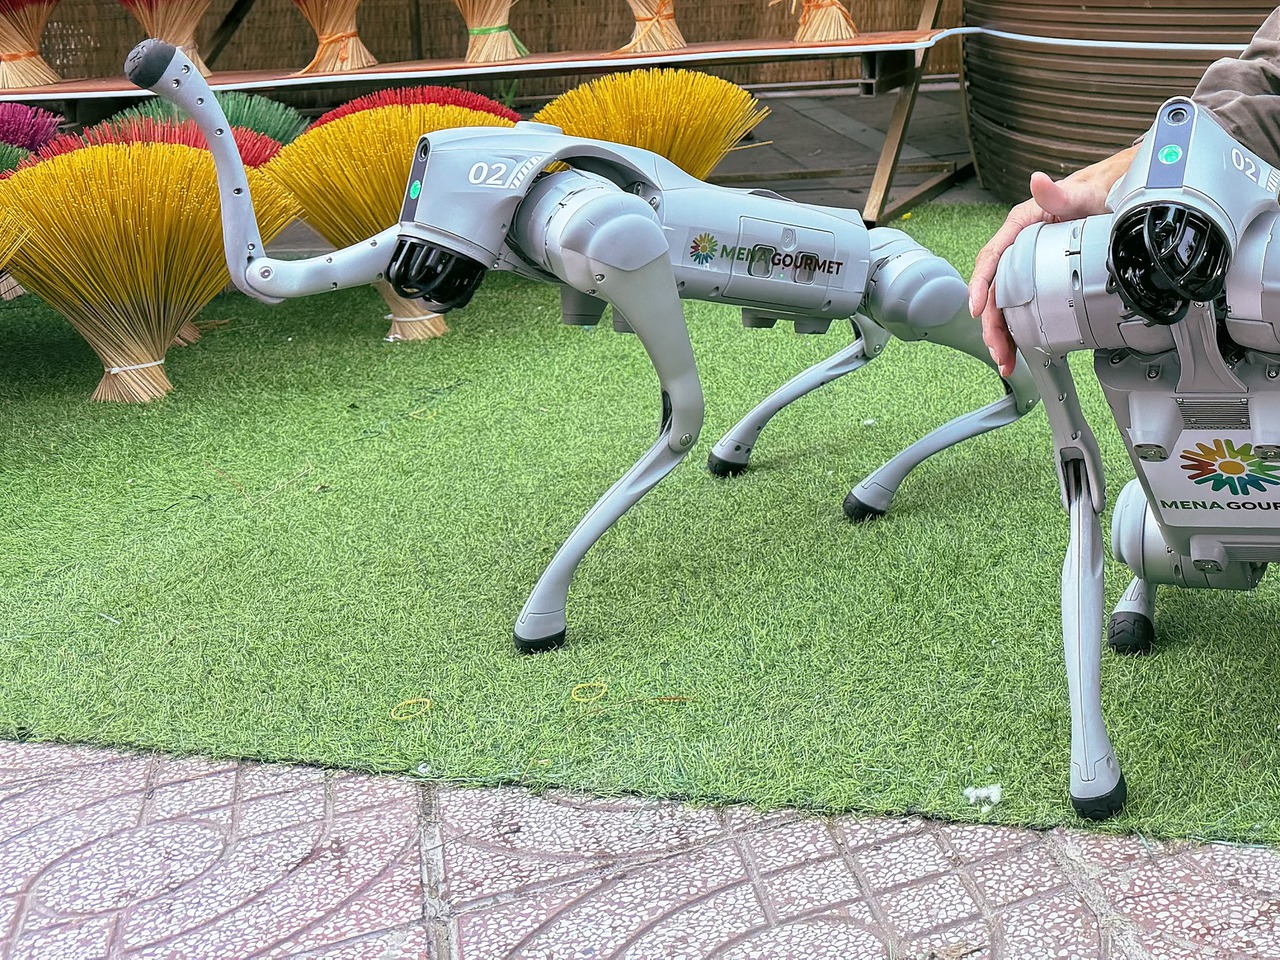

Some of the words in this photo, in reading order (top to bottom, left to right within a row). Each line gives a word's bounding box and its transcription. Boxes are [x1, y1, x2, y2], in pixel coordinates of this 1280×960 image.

[468, 161, 508, 185] 02
[1231, 147, 1257, 183] 02
[720, 244, 769, 265] MENA
[771, 252, 844, 275] GOURMET
[1160, 499, 1225, 510] MENA
